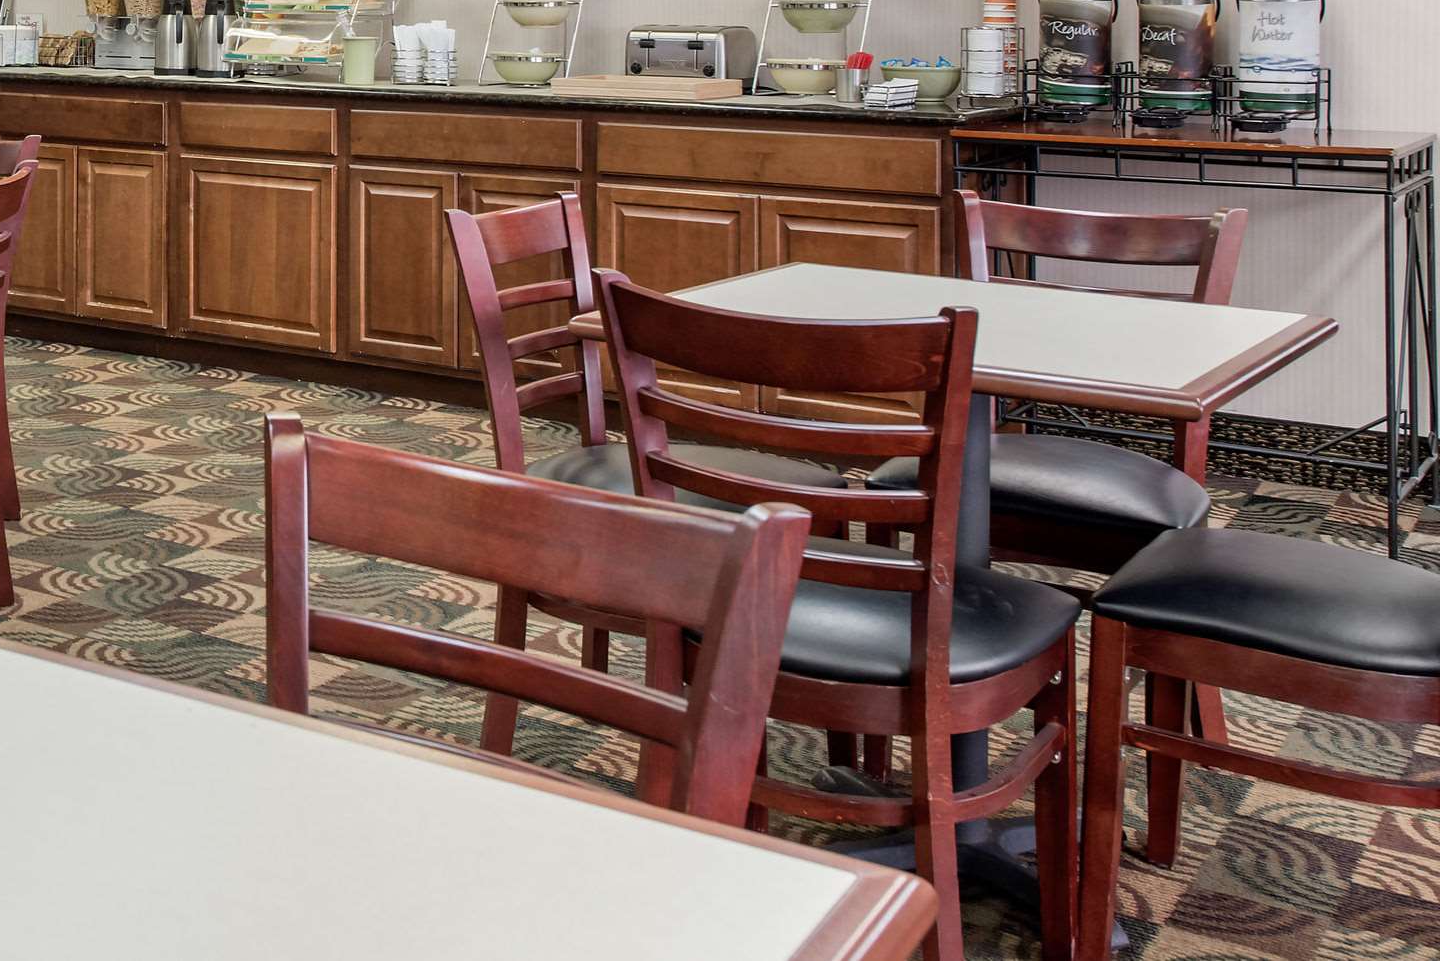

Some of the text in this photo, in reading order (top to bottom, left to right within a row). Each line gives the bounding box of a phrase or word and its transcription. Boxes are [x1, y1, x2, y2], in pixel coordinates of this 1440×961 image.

[1256, 11, 1286, 27] Hot
[1048, 21, 1098, 39] Regular
[1142, 25, 1177, 46] Decaf
[1251, 26, 1294, 43] Water
